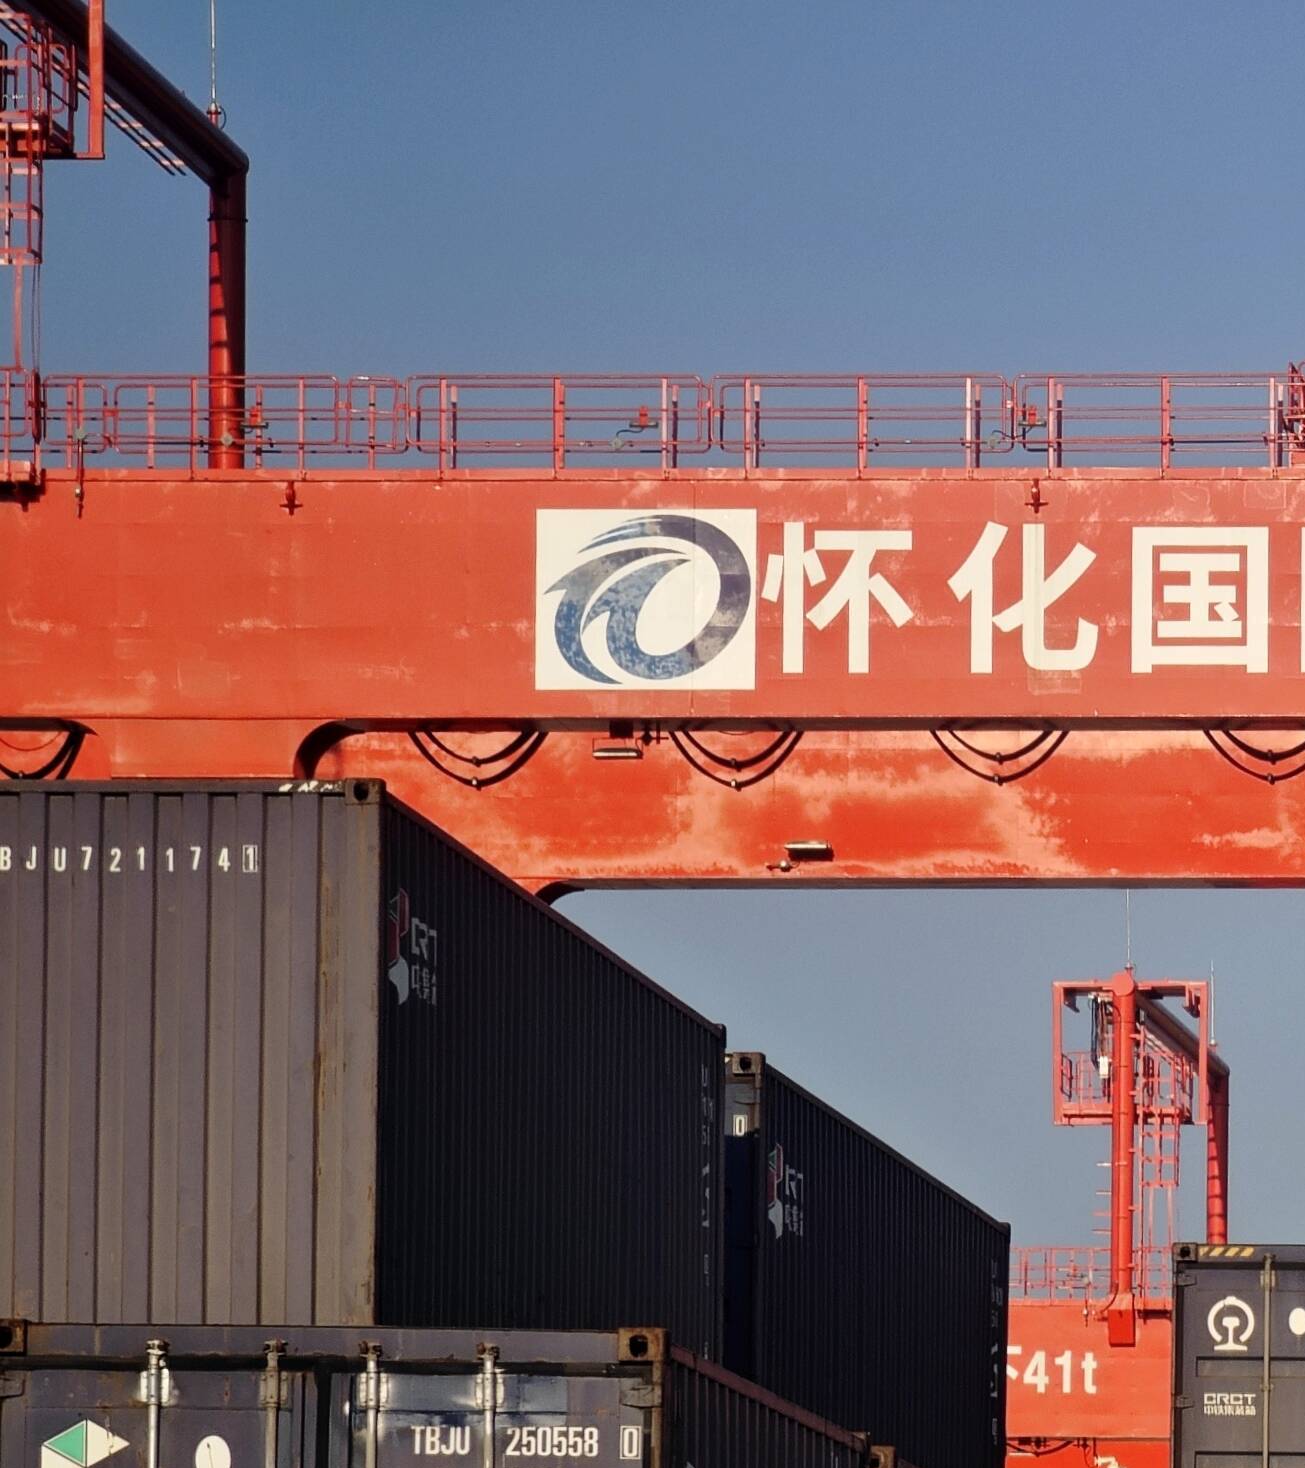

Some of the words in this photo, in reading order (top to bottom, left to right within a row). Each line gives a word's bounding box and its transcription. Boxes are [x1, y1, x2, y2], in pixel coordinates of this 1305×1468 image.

[1204, 1393, 1256, 1405] CRCT
[411, 1425, 470, 1455] TBJU
[506, 1427, 599, 1457] 250558
[621, 1427, 641, 1459] 0
